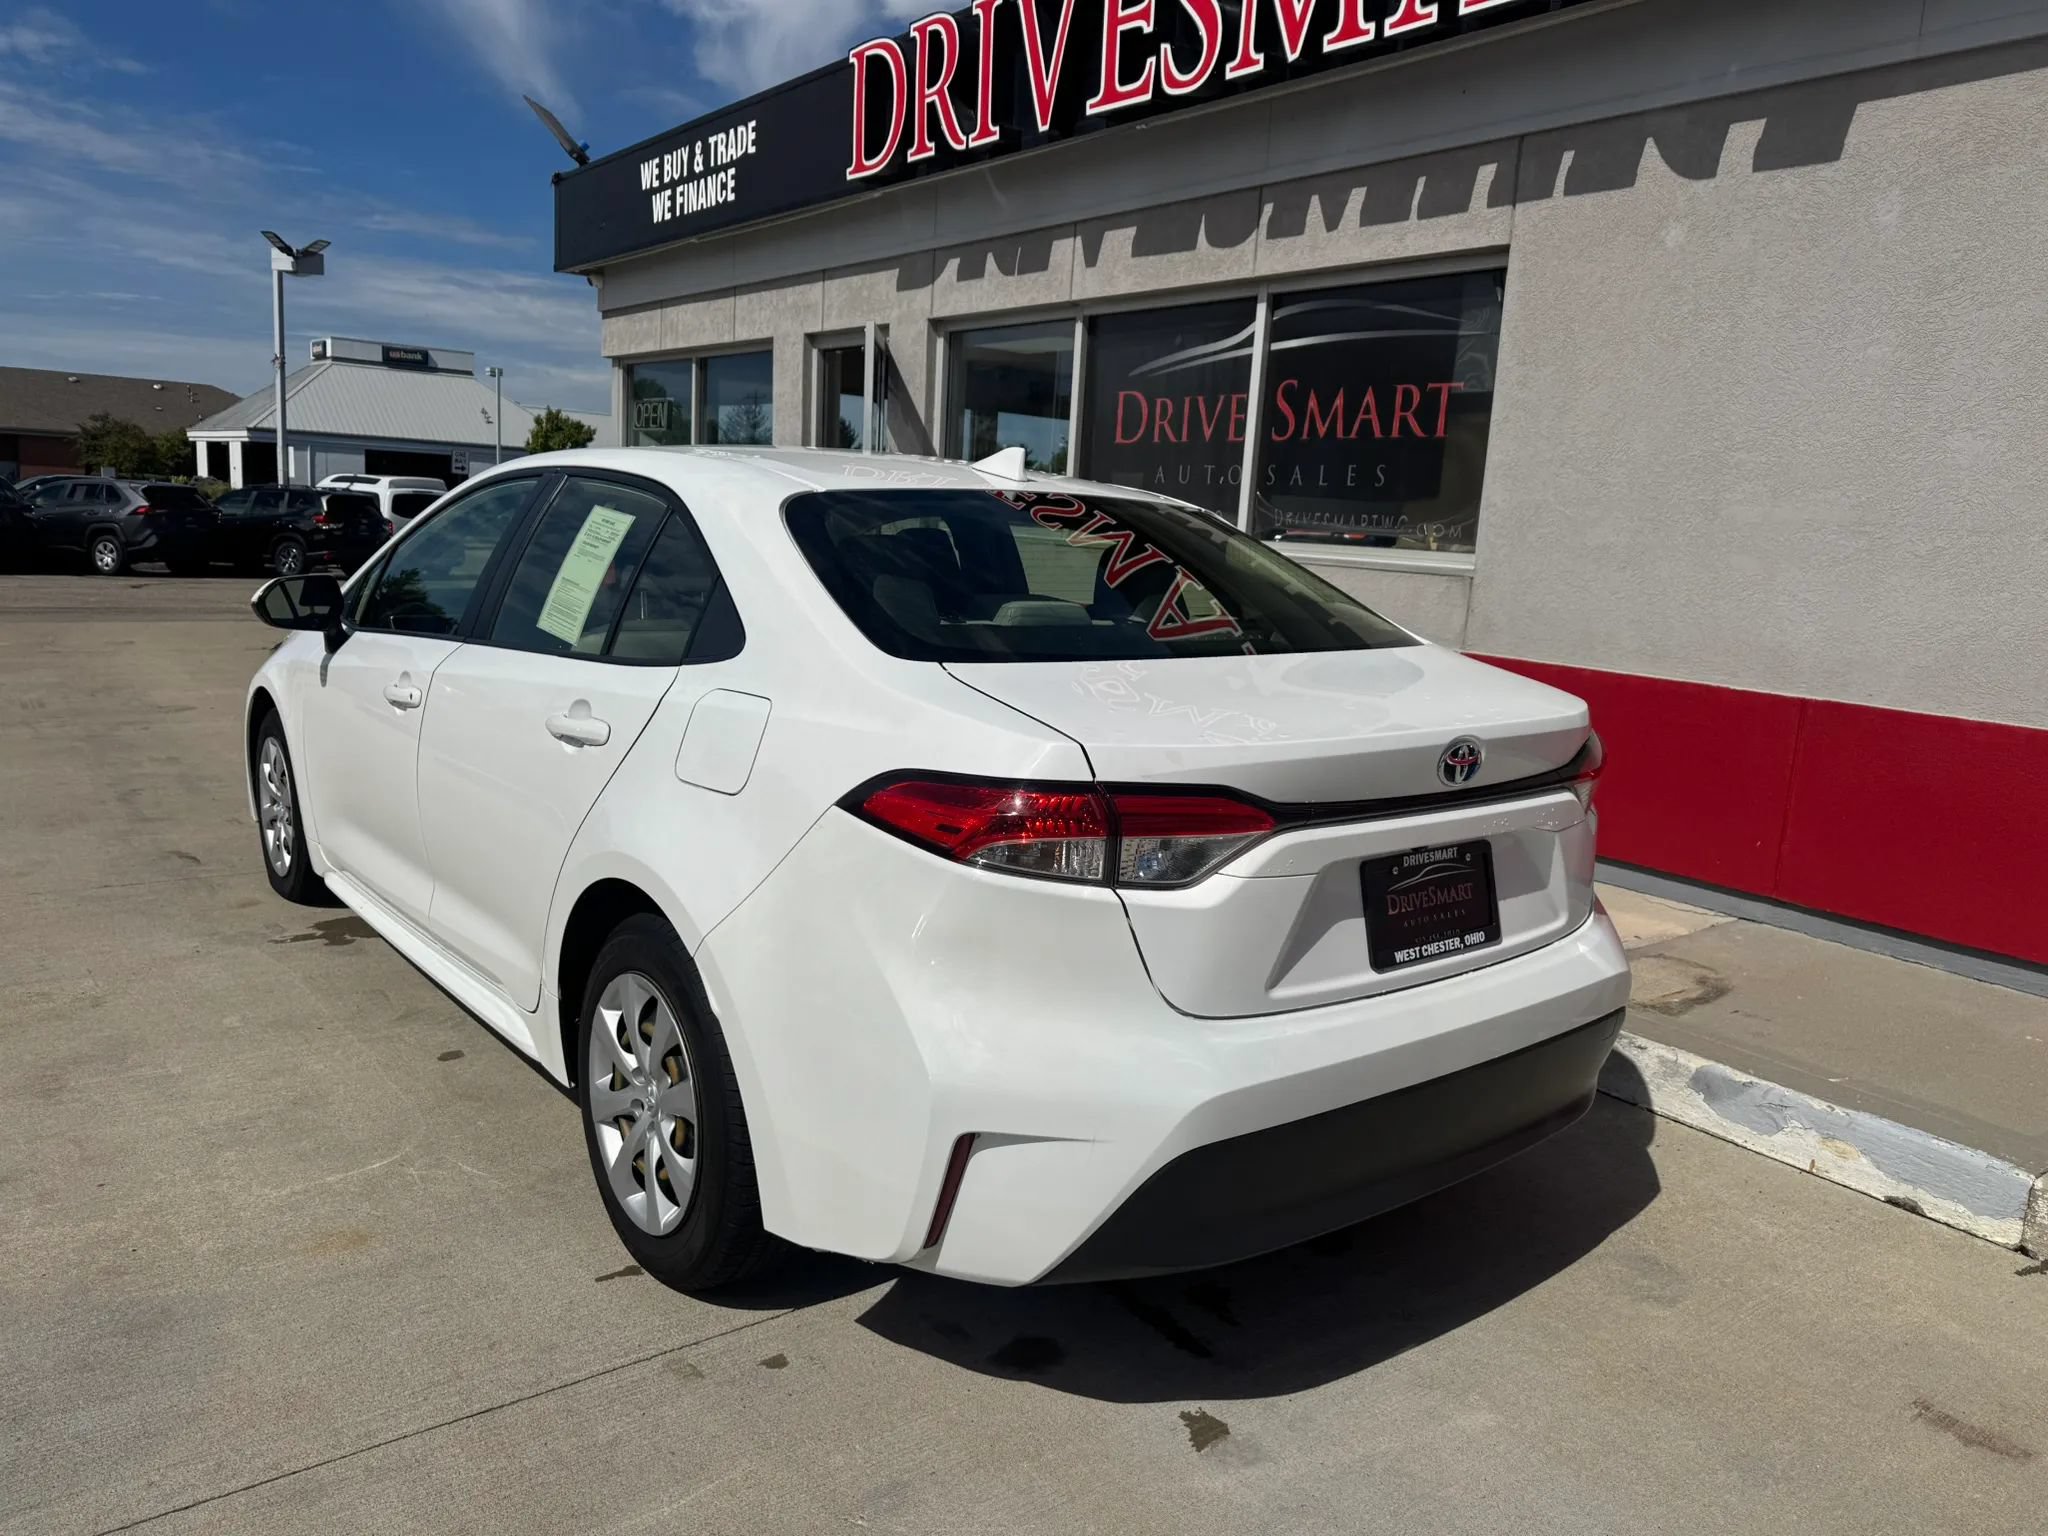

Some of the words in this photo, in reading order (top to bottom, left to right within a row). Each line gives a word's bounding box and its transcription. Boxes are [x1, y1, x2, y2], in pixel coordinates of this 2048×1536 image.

[640, 157, 660, 191] WE
[663, 145, 690, 183] BUY
[693, 140, 704, 174] &
[708, 120, 756, 167] TRADE
[652, 188, 672, 224] WE
[676, 167, 736, 217] FINANCE
[636, 402, 665, 428] OPEN
[1155, 464, 1242, 486] AUTO
[1266, 464, 1386, 487] SALES
[1403, 847, 1458, 867] DRIVESMART
[1394, 946, 1420, 963] WEST
[1421, 937, 1464, 957] CHESTER,
[1464, 931, 1485, 947] OHIO
